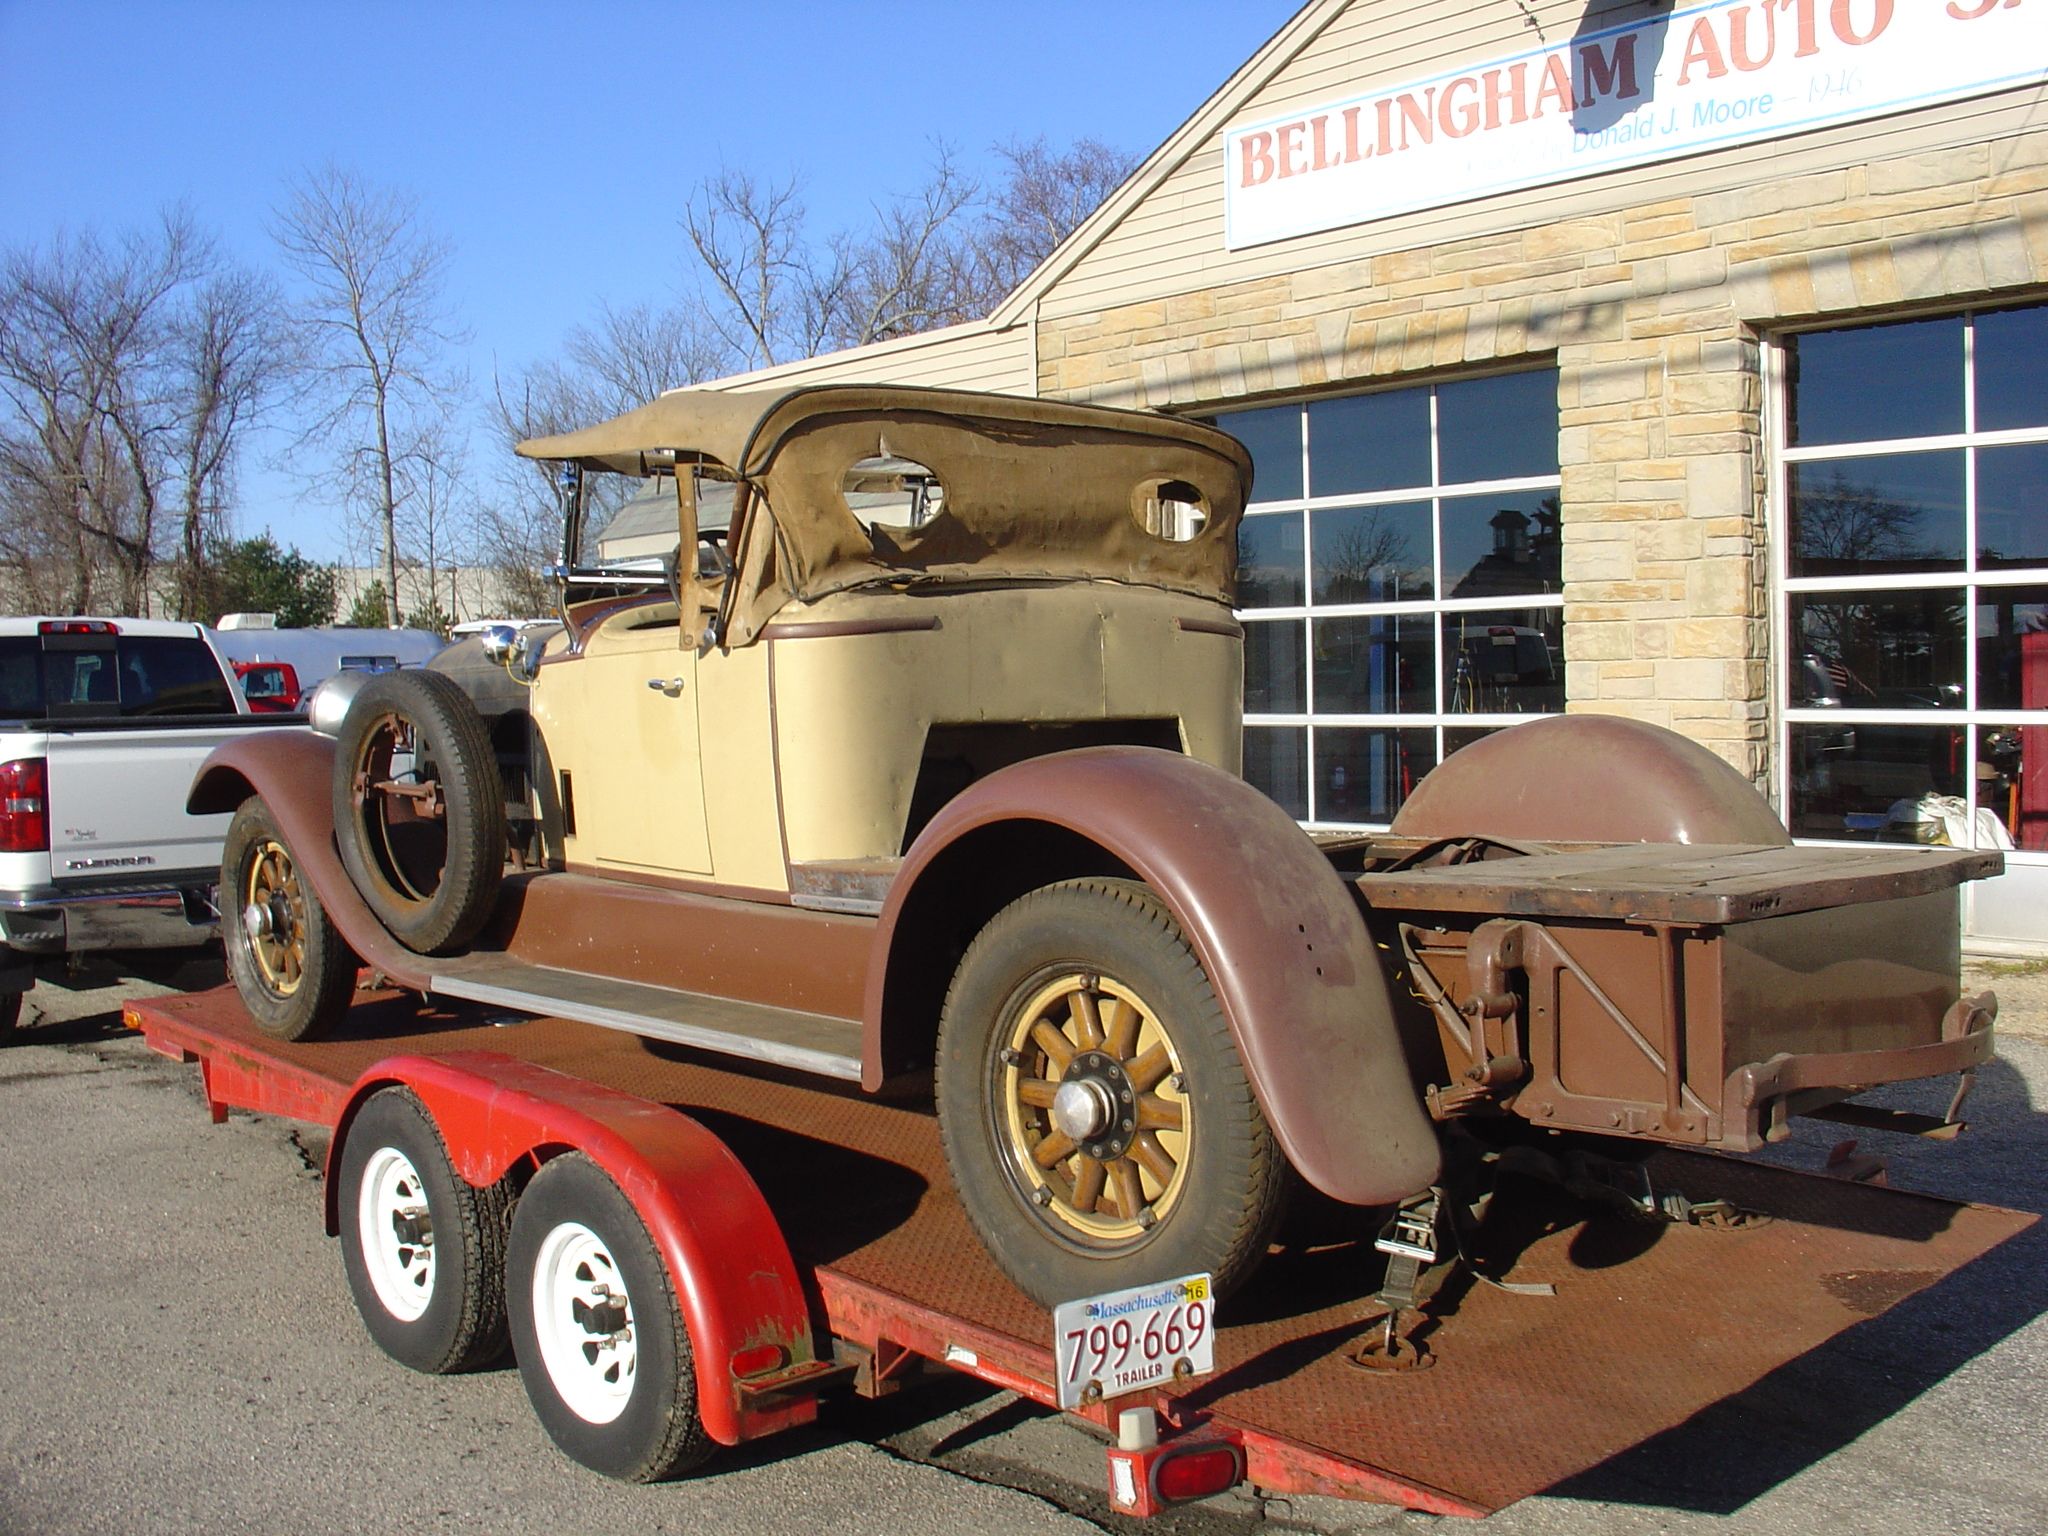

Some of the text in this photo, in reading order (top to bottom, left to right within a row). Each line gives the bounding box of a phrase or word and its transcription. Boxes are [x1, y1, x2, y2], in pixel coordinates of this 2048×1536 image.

[1240, 0, 1895, 189] BELLINGHAM AUTO
[1572, 117, 1654, 154] Donald
[1661, 108, 1680, 136] J.
[1693, 92, 1774, 129] Moore
[1093, 1289, 1178, 1320] Massachusetts
[1188, 1285, 1204, 1299] 16
[1114, 1363, 1163, 1387] TRAILER
